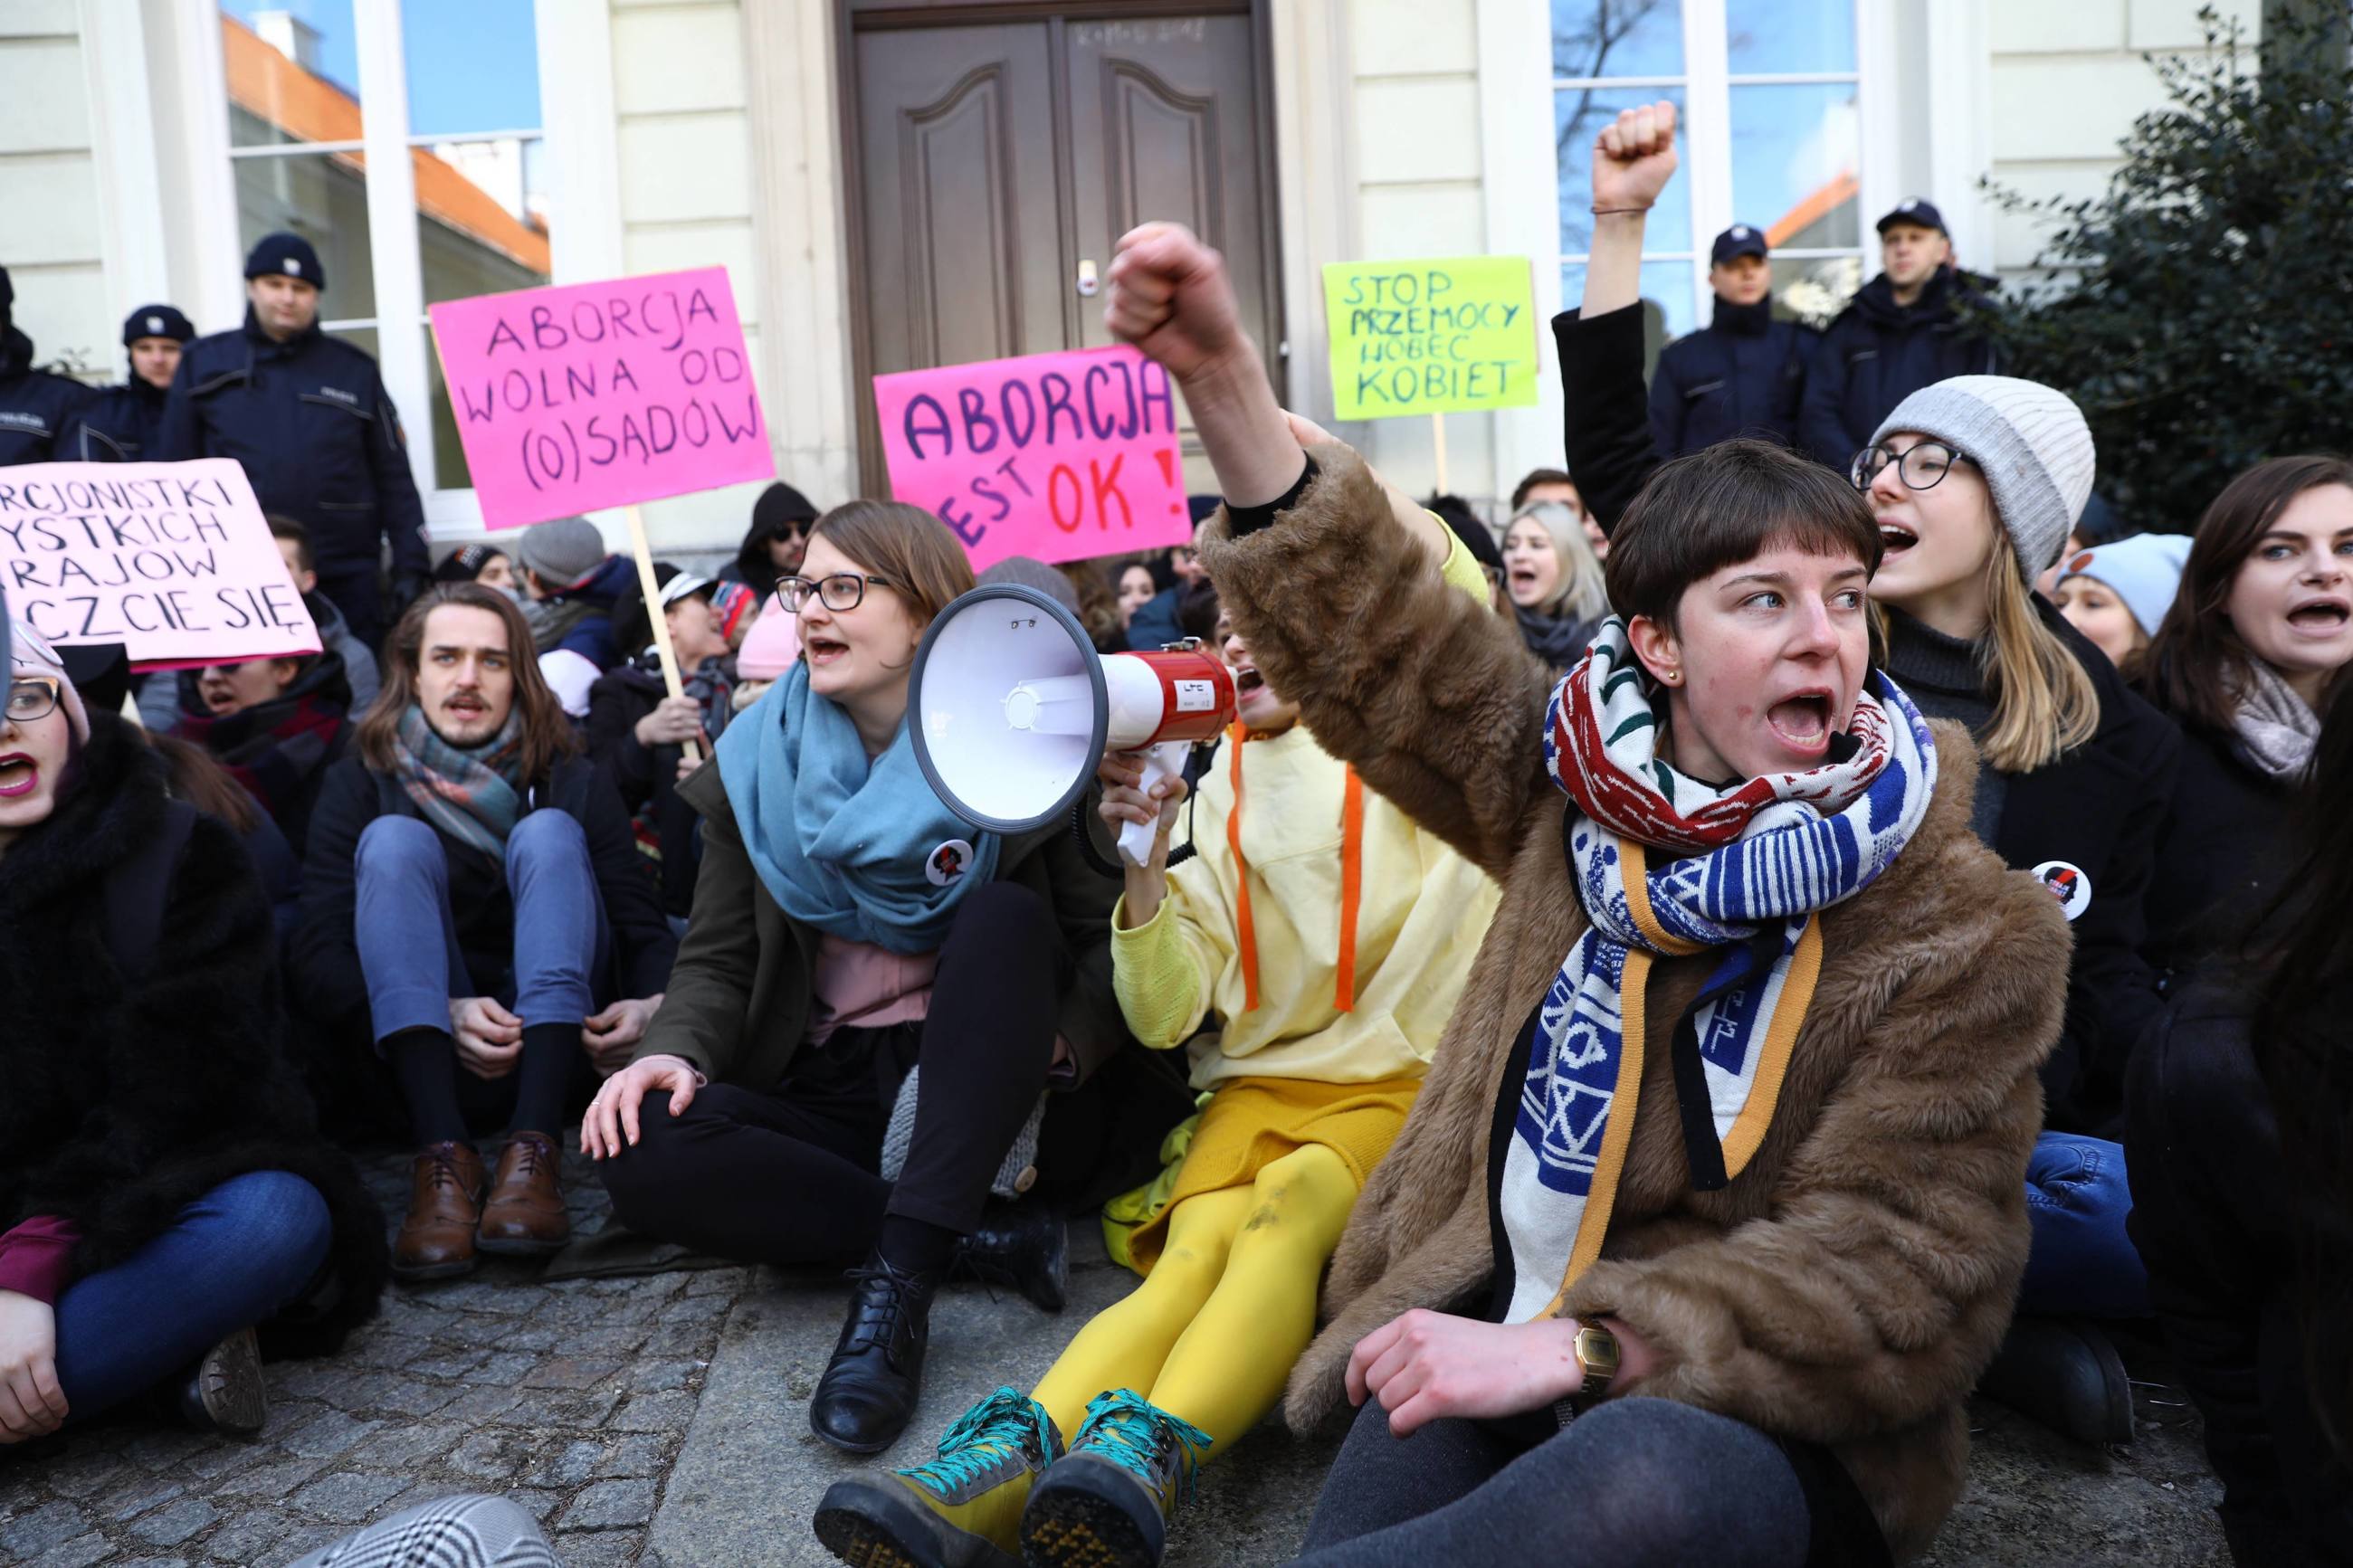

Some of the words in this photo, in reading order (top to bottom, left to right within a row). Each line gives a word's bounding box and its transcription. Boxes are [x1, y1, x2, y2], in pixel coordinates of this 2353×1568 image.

[1344, 271, 1452, 305] STOP
[486, 288, 719, 356] ABORCJA
[1350, 302, 1519, 337] PRZEMOCY
[460, 357, 638, 423] WOLNA
[680, 347, 744, 386] OD
[1357, 361, 1520, 405] KOBIET
[902, 357, 1176, 460] ABORCJA
[0, 479, 233, 516] RCJONISTKI
[0, 511, 229, 554] YSTKICH
[0, 547, 217, 589] RAJOW
[216, 584, 304, 637] SIĘ
